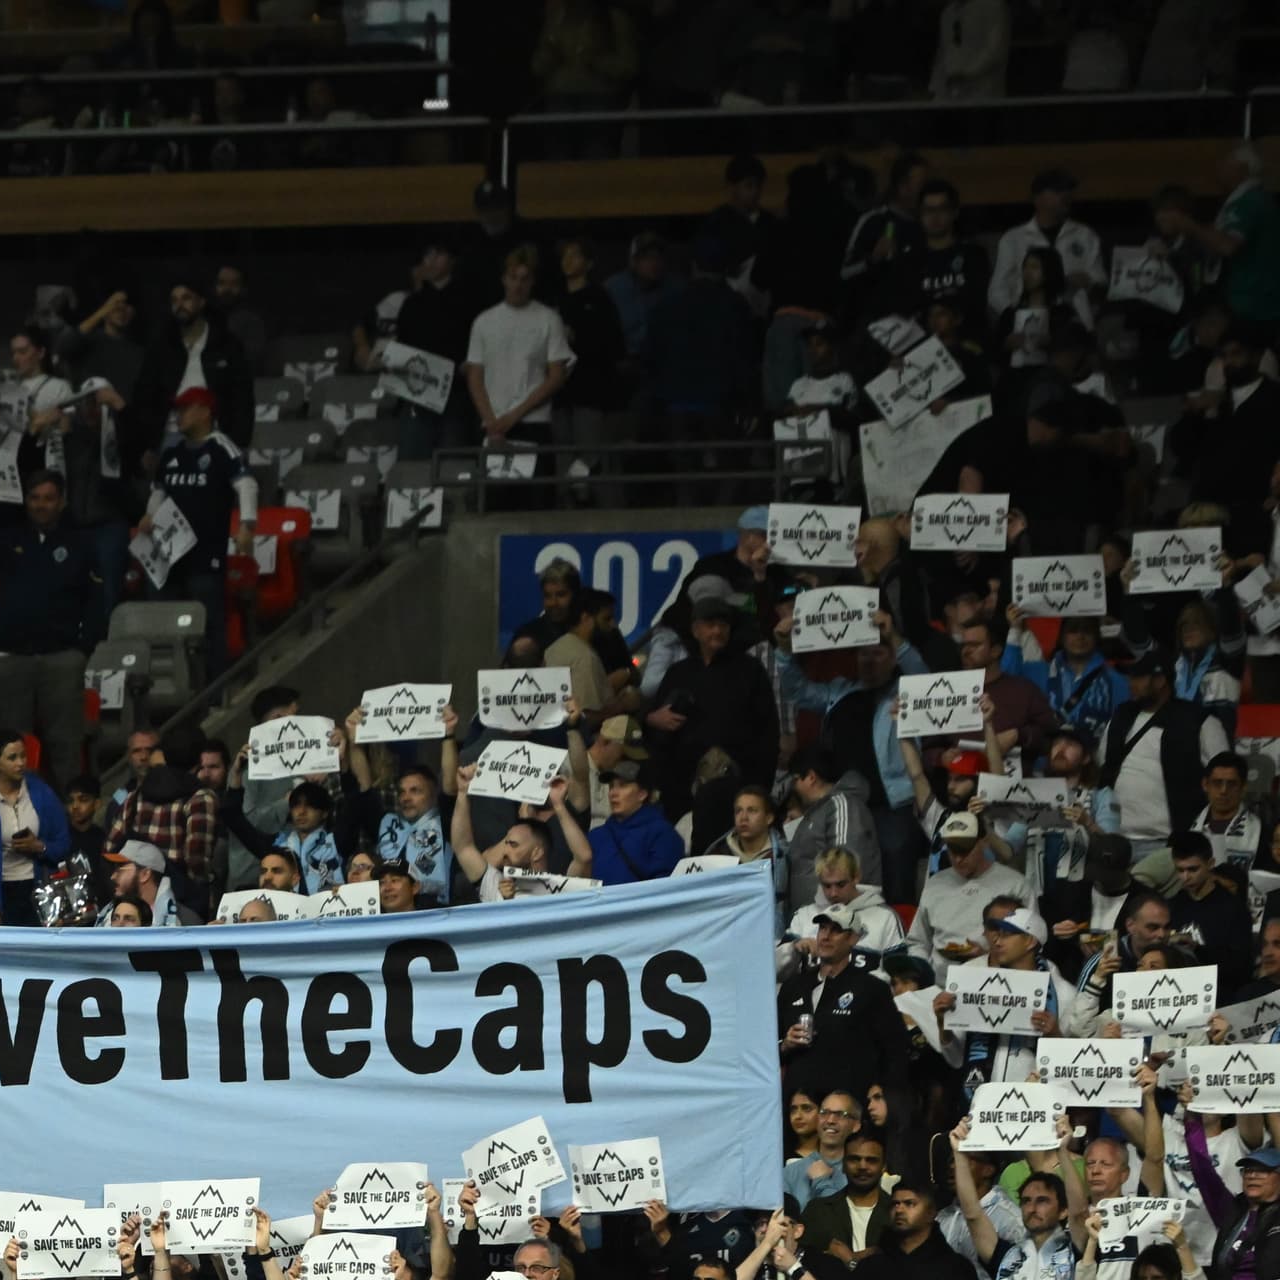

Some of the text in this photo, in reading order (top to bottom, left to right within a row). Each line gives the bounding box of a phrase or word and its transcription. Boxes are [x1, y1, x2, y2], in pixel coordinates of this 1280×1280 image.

[165, 473, 208, 486] TELUS
[928, 513, 950, 526] SAVE
[966, 513, 990, 527] CAPS
[494, 693, 517, 707] SAVE
[532, 691, 557, 705] CAPS
[912, 697, 932, 711] SAVE
[945, 694, 967, 707] CAPS
[1130, 996, 1155, 1011] SAVE
[1172, 993, 1198, 1007] CAPS
[1054, 1065, 1077, 1078] SAVE
[1096, 1066, 1123, 1078] CAPS
[33, 1238, 57, 1251] SAVE
[75, 1236, 101, 1250] CAPS
